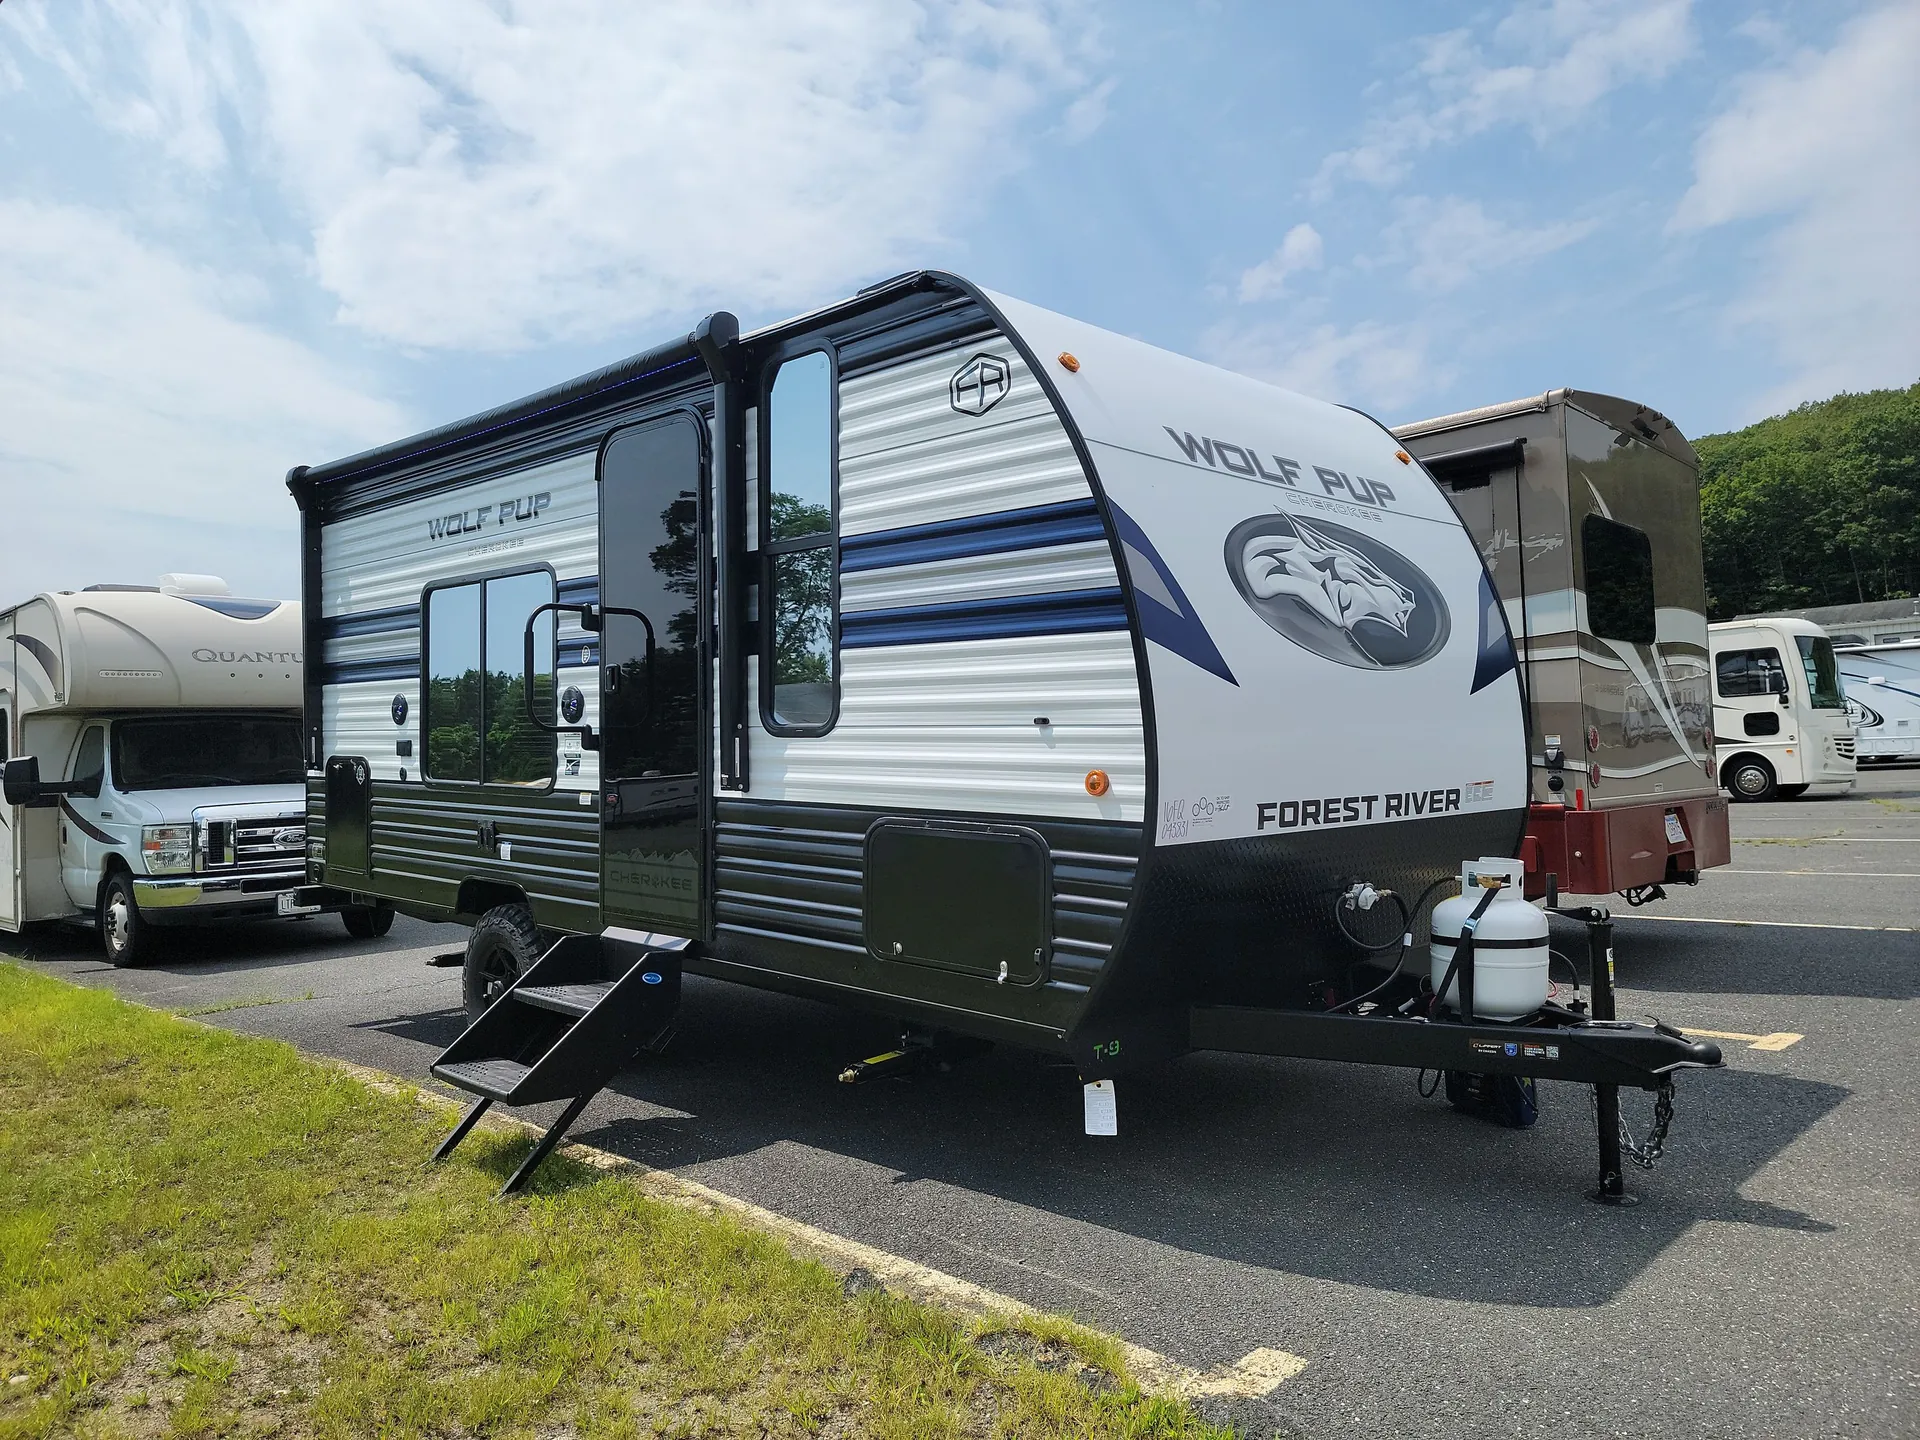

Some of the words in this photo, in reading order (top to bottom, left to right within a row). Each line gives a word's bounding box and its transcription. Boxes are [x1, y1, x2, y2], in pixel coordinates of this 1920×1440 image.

[1161, 425, 1301, 487] WOLF
[1312, 465, 1397, 508] PUP
[427, 506, 493, 541] WOLF
[499, 491, 551, 527] PUP
[1285, 491, 1383, 523] CHEROKEE
[467, 538, 524, 557] CHEROKEE
[1256, 795, 1379, 831] FOREST
[1384, 788, 1461, 818] RIVER
